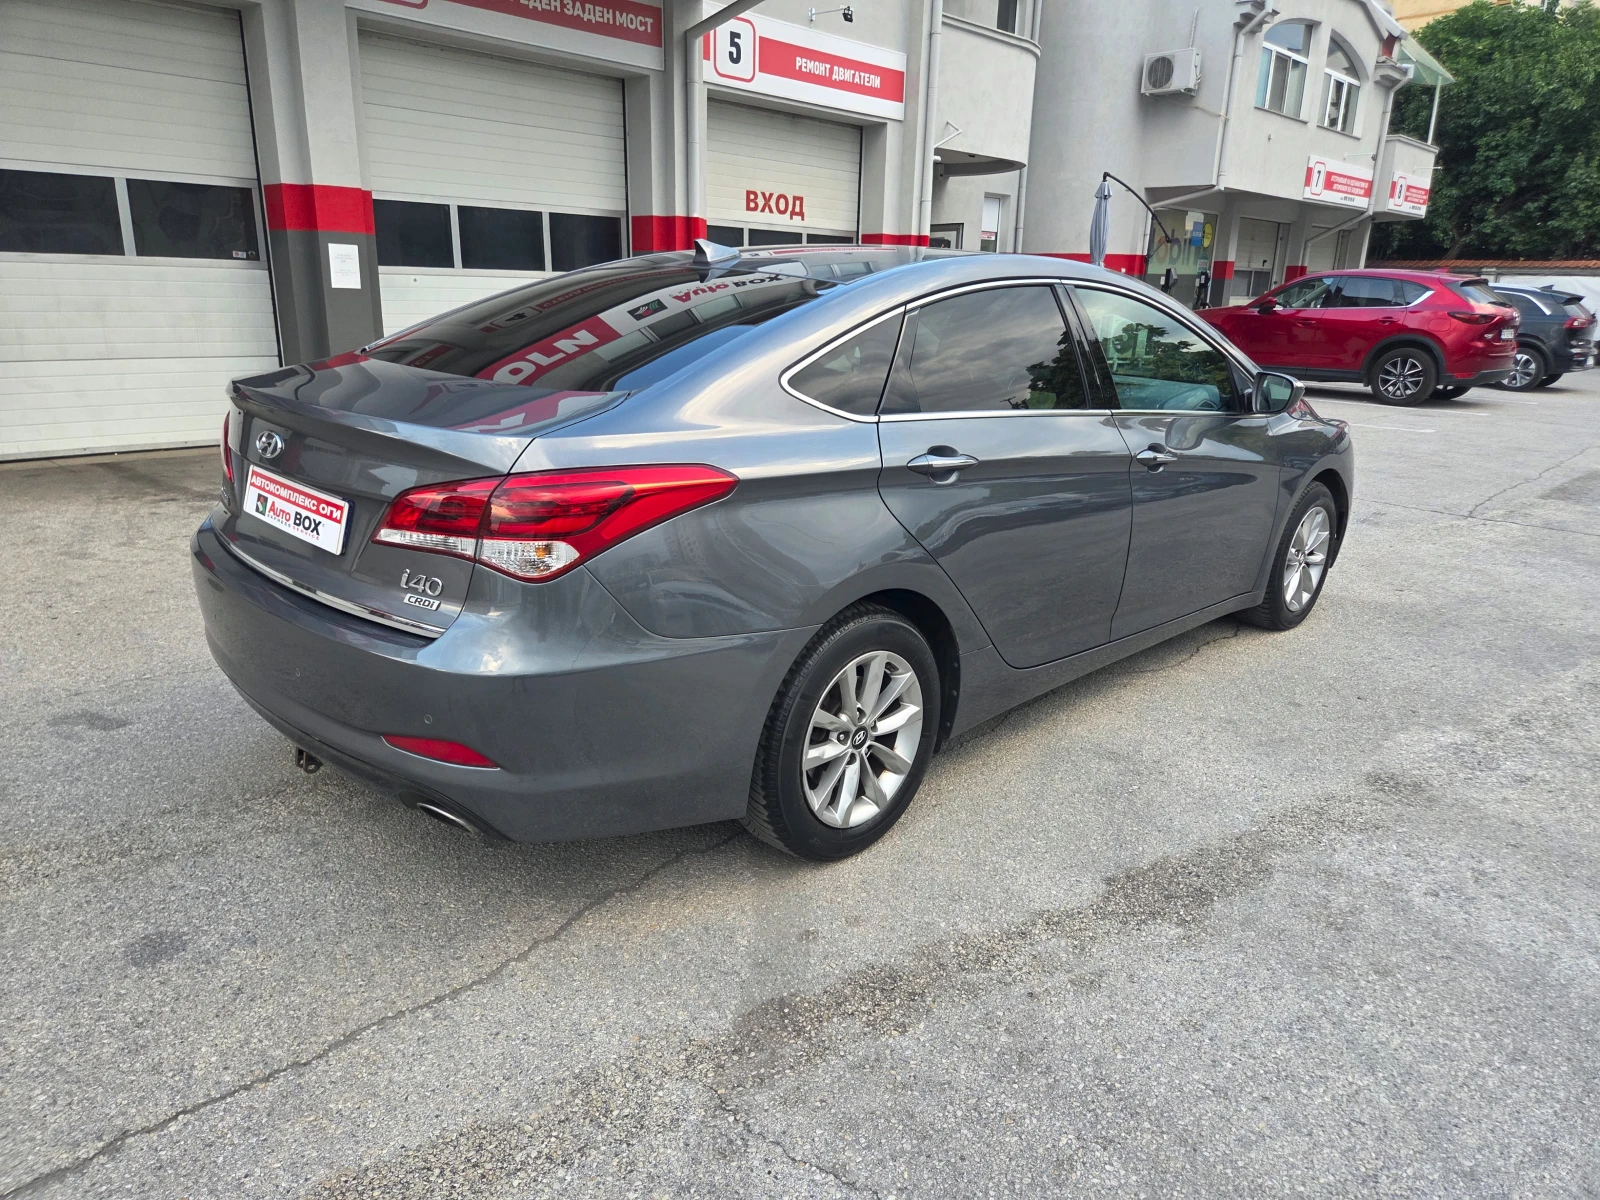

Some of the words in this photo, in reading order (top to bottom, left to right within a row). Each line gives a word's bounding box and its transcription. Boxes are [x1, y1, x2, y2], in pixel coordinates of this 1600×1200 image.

[563, 0, 614, 24] ЗАДЕН
[615, 10, 654, 33] МОСТ
[728, 31, 742, 64] 5
[795, 57, 831, 78] РЕМОНТ
[832, 66, 881, 88] ДВИГАТЕЛИ
[745, 189, 805, 221] ВХОД
[250, 475, 318, 510] АВТОКОМПЛЕКС
[319, 503, 342, 521] ОГИ
[293, 511, 323, 536] BOX
[400, 568, 444, 597] i40
[407, 595, 436, 609] CRDi
